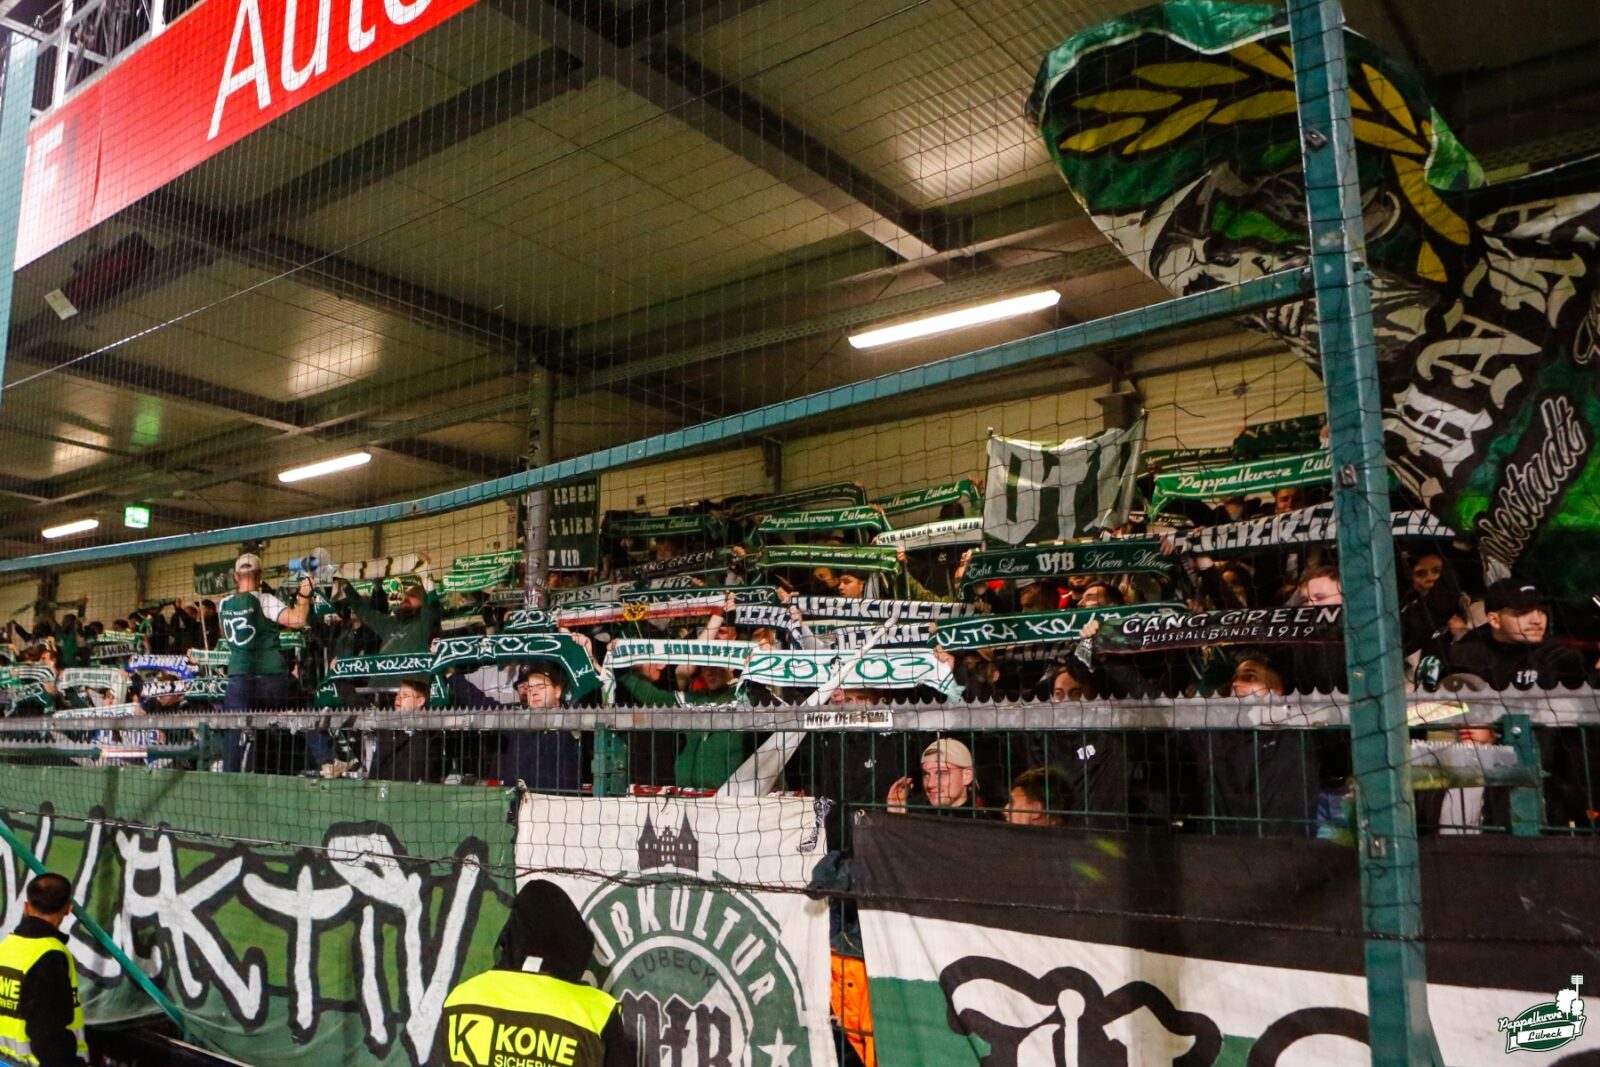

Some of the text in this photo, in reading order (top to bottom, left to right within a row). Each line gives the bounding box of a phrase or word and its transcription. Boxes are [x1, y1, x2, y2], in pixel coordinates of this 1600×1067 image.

[1122, 607, 1342, 635] GANG GREEN
[1266, 626, 1315, 638] 1919
[586, 884, 776, 1006] UBKULTUR
[495, 1023, 578, 1066] KONE
